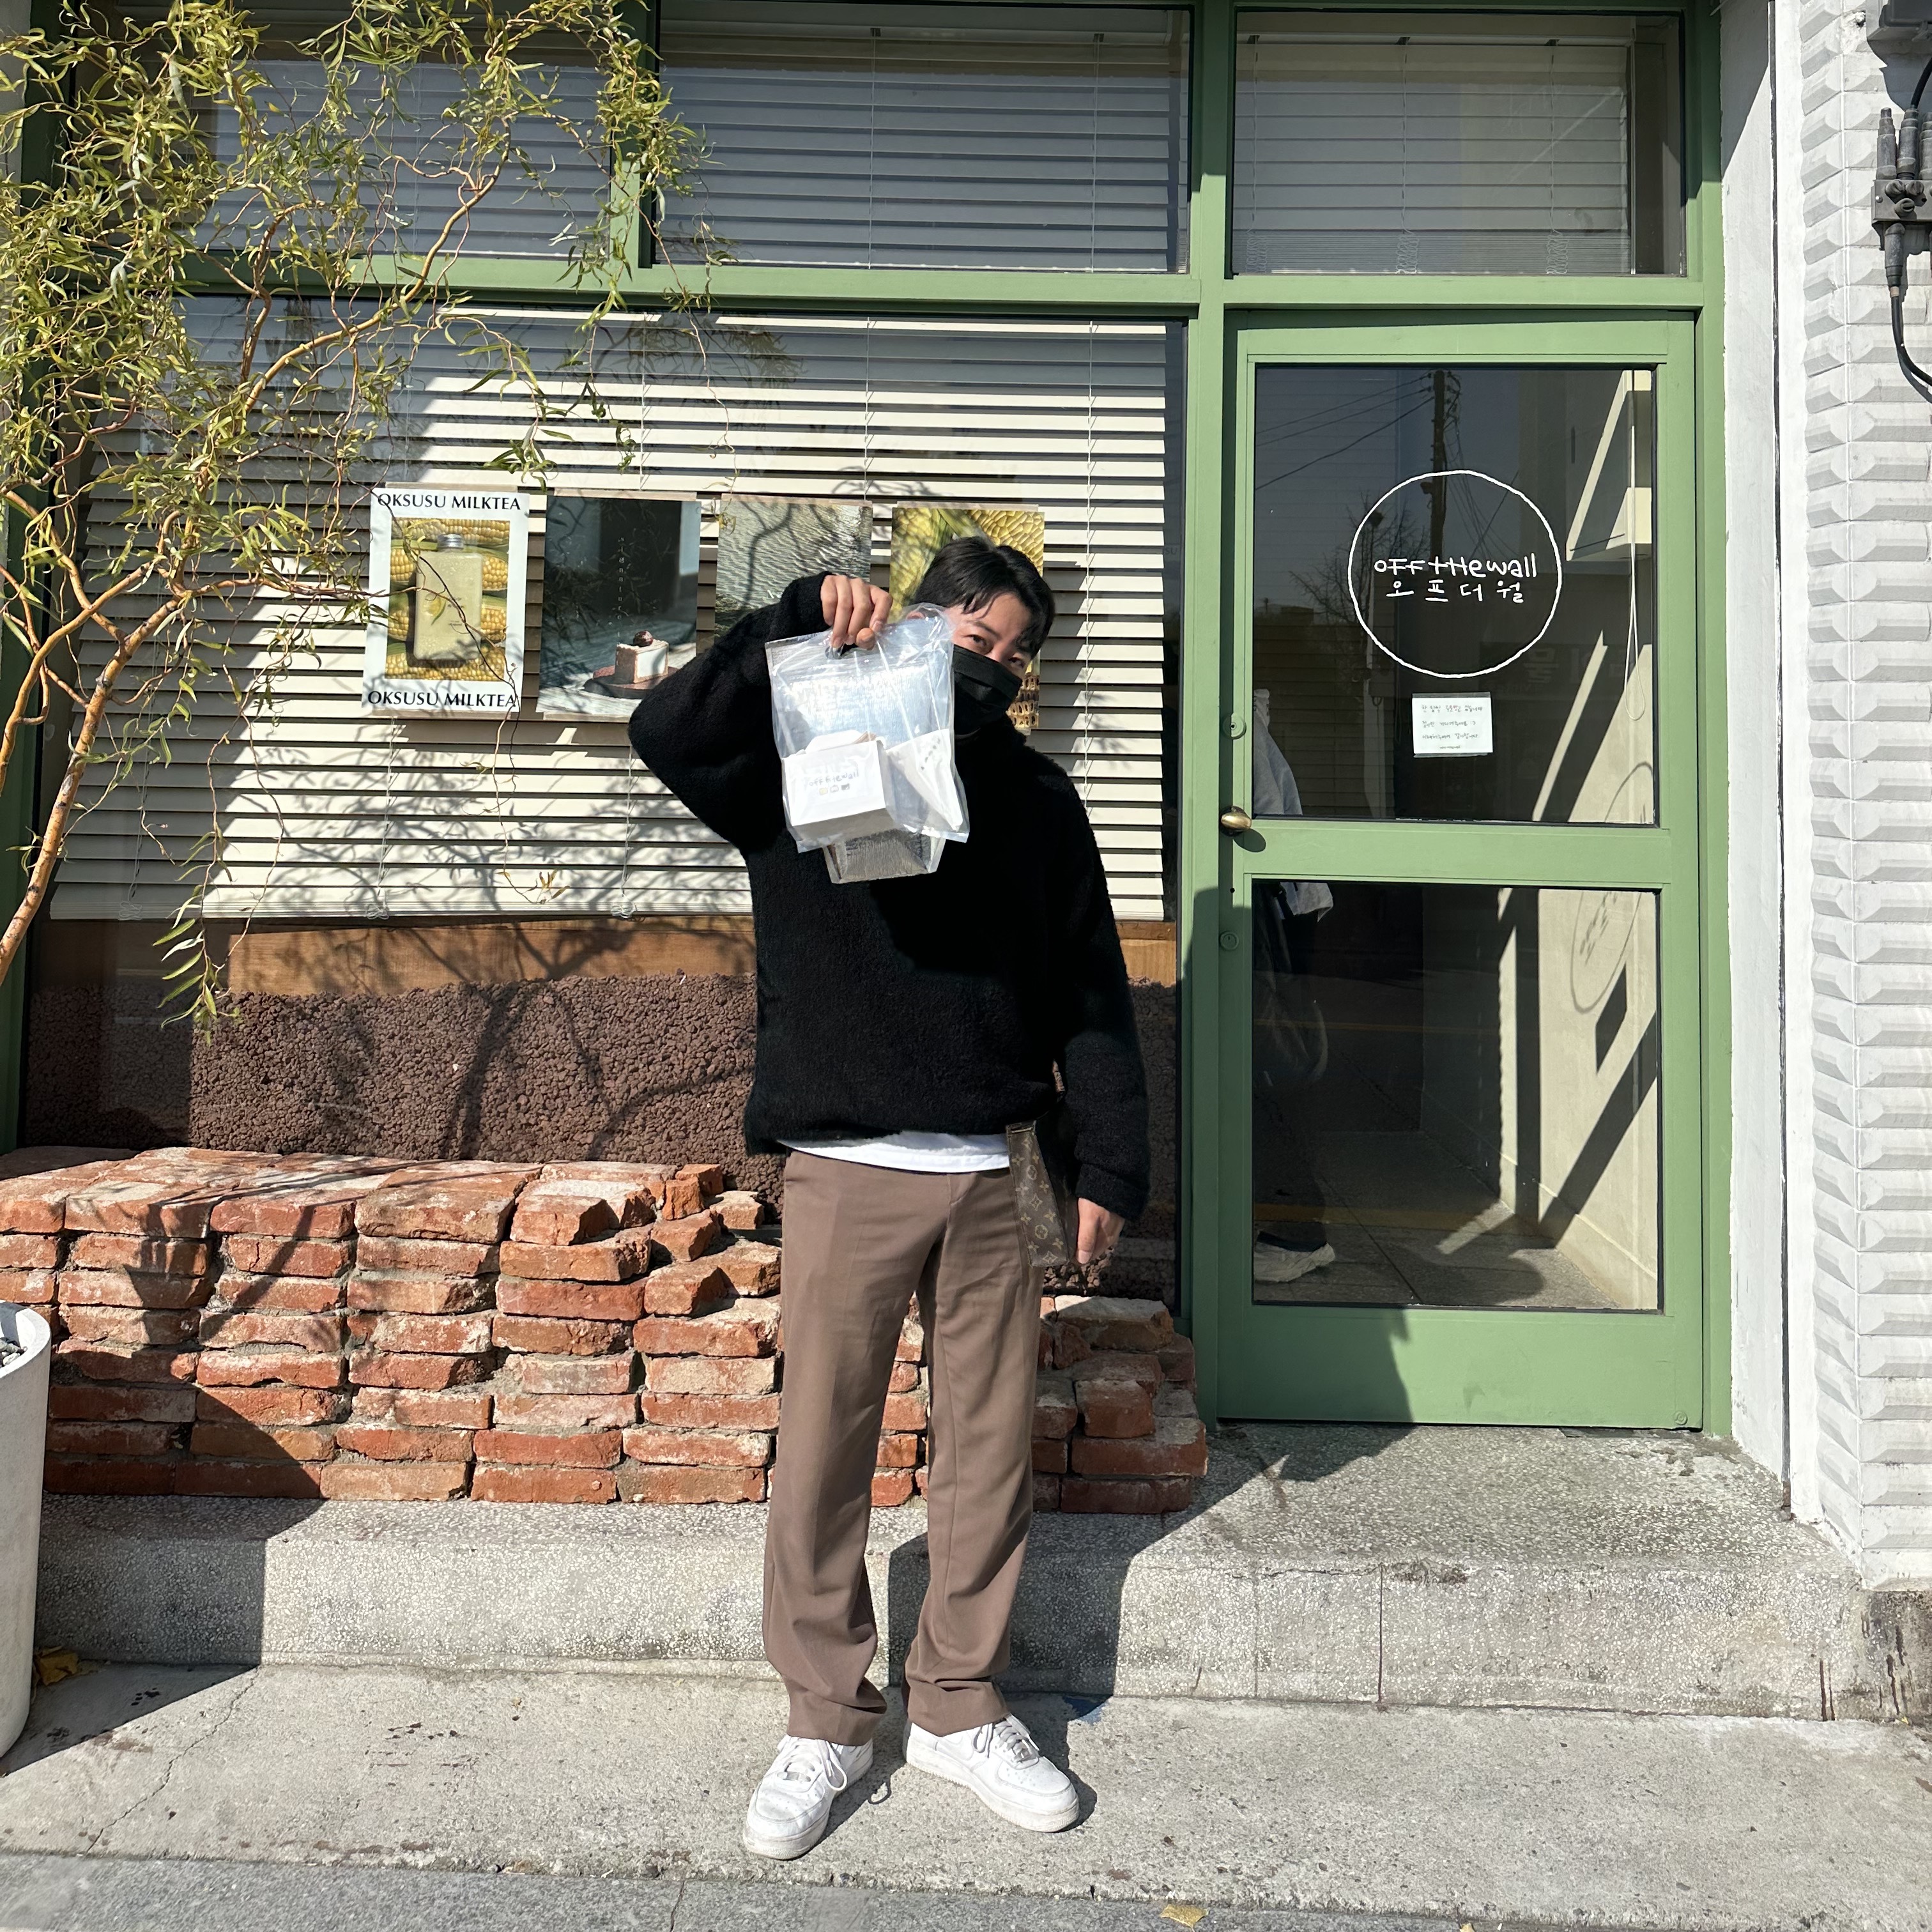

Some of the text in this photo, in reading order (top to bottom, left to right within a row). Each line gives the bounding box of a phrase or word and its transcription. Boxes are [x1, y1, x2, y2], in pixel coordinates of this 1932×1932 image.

[378, 493, 521, 510] OKSUSU MILKTEA
[367, 691, 516, 707] OKSUSU MILKTEA
